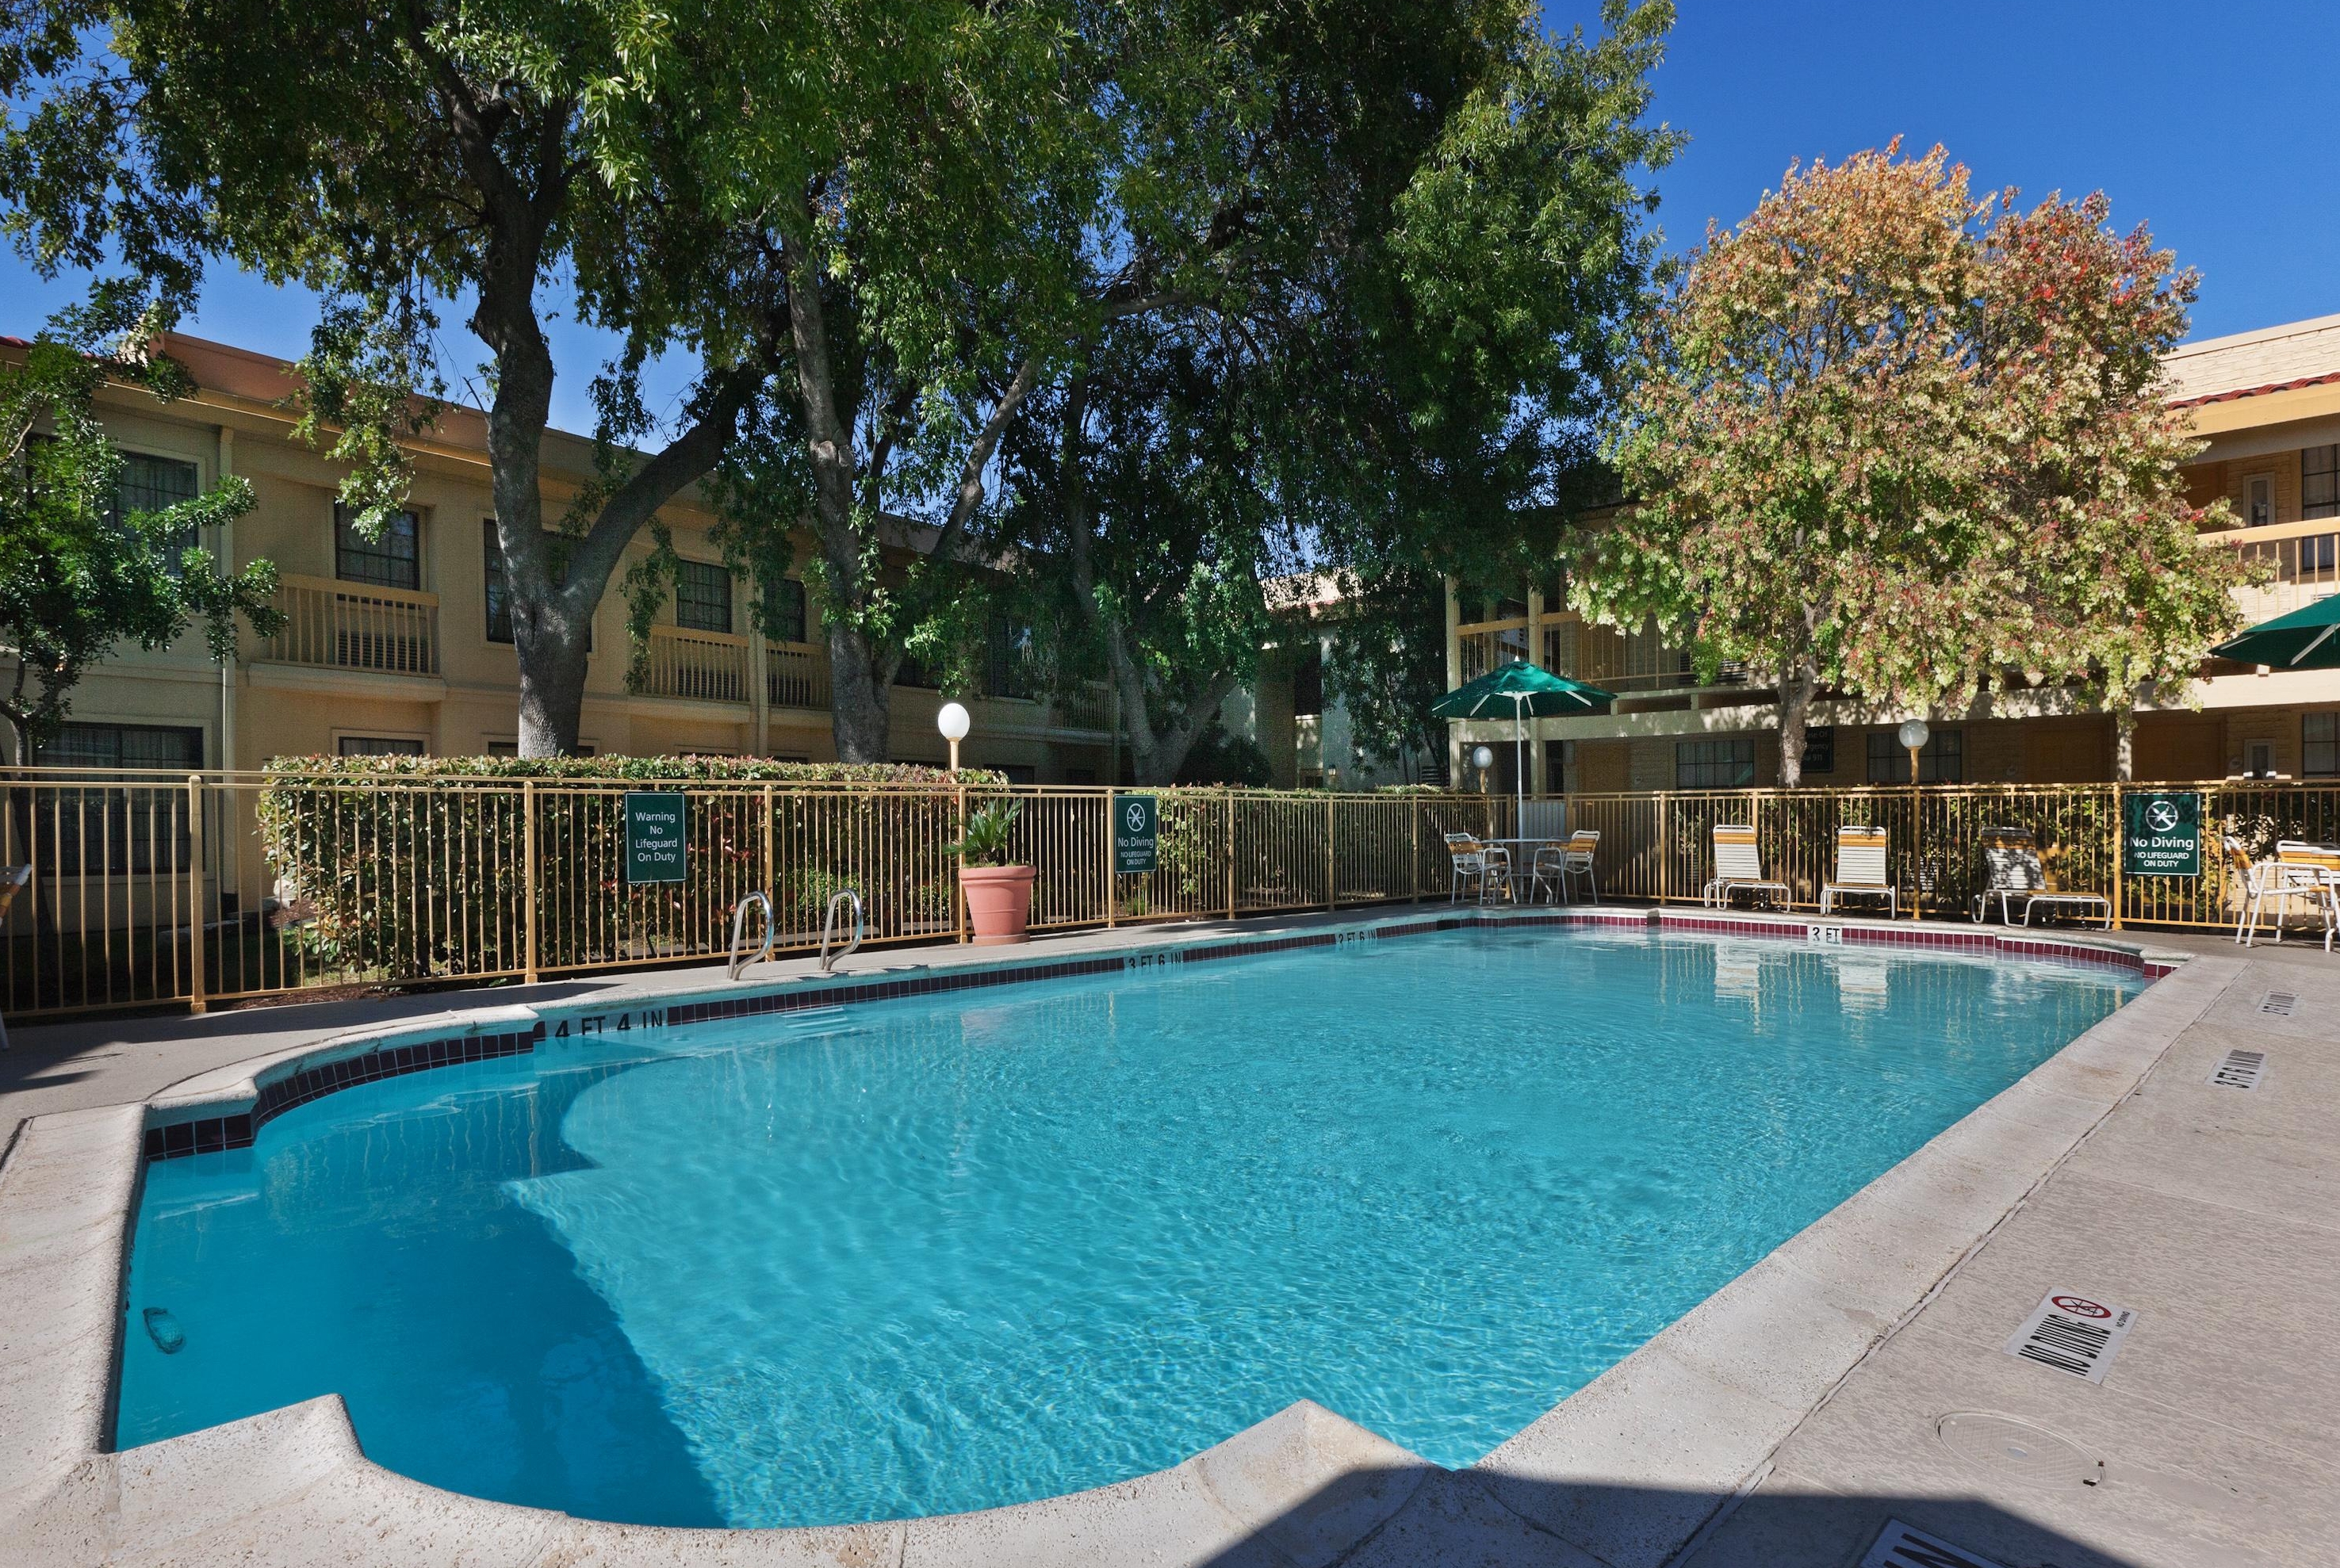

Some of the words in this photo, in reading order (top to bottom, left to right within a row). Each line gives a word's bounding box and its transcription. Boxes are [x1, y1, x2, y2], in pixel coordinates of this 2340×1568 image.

[1806, 742, 1829, 751] rgency
[635, 812, 676, 824] Warning
[649, 825, 663, 835] No
[635, 838, 677, 850] Lifeguard
[1117, 837, 1128, 847] No
[1131, 836, 1154, 848] Diving
[2130, 837, 2148, 847] No
[2151, 836, 2194, 851] Diving
[638, 852, 651, 862] On
[654, 852, 676, 862] Duty
[1368, 930, 1375, 939] IN
[1826, 927, 1840, 937] FT
[1128, 958, 1136, 969] 3
[1141, 955, 1153, 968] FT
[1158, 954, 1165, 966] 6
[1171, 953, 1181, 964] IN
[555, 1020, 570, 1037] 4
[581, 1015, 606, 1035] FT
[617, 1013, 631, 1031] 4
[642, 1010, 663, 1029] IN
[2216, 1072, 2254, 1084] FT
[2214, 1080, 2250, 1089] 3
[2030, 1314, 2112, 1360] DIVING
[2018, 1344, 2091, 1376] NO
